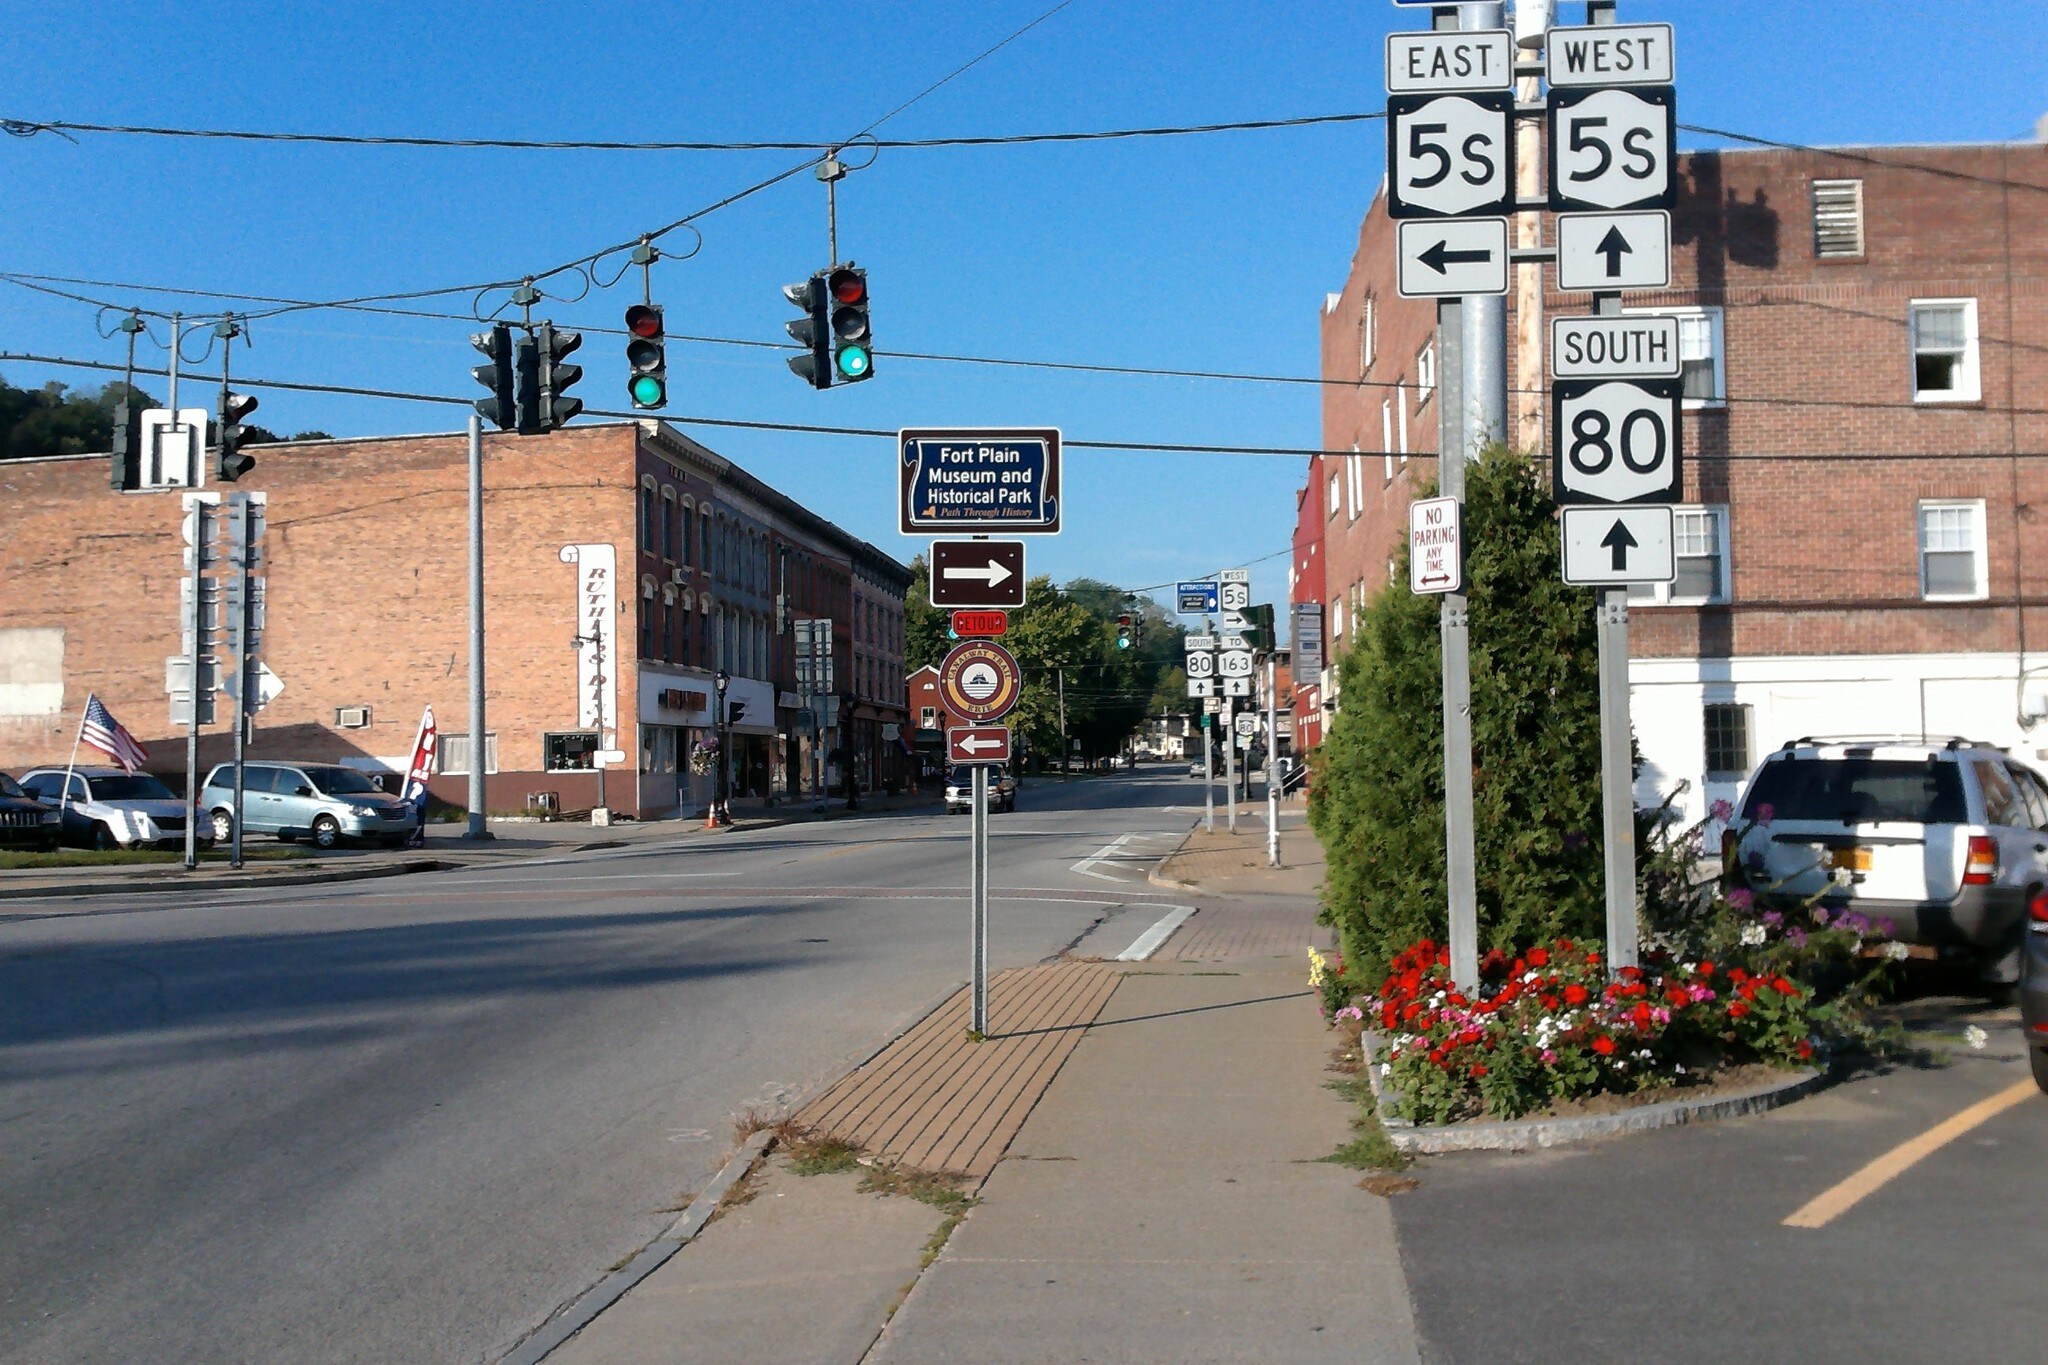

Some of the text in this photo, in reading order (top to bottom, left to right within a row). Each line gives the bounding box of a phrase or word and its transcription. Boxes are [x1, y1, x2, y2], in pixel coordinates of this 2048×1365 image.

[1408, 44, 1493, 79] EAST
[1564, 37, 1655, 73] WEST
[1409, 123, 1495, 189] 5S
[1569, 116, 1656, 183] 5S
[1565, 330, 1668, 365] SOUTH
[1569, 408, 1667, 475] 80
[940, 447, 1020, 463] Fort Plain
[929, 468, 1032, 483] Museum and
[928, 488, 1032, 504] Historical Park
[940, 507, 1033, 518] Path Through History
[1426, 507, 1442, 526] NO
[1414, 526, 1455, 547] PARKING
[1426, 547, 1442, 559] ANY
[1426, 560, 1443, 572] TIME
[1224, 571, 1245, 580] WEST
[1224, 589, 1246, 605] 5S
[957, 615, 1002, 631] DETOUR
[1187, 638, 1212, 647] SOUTH
[1229, 638, 1242, 646] TO
[948, 650, 1011, 680] CANALWAY TRAIL
[1189, 656, 1211, 672] 80
[1222, 657, 1249, 671] 163
[967, 704, 994, 713] ERIE
[1240, 723, 1253, 732] 80
